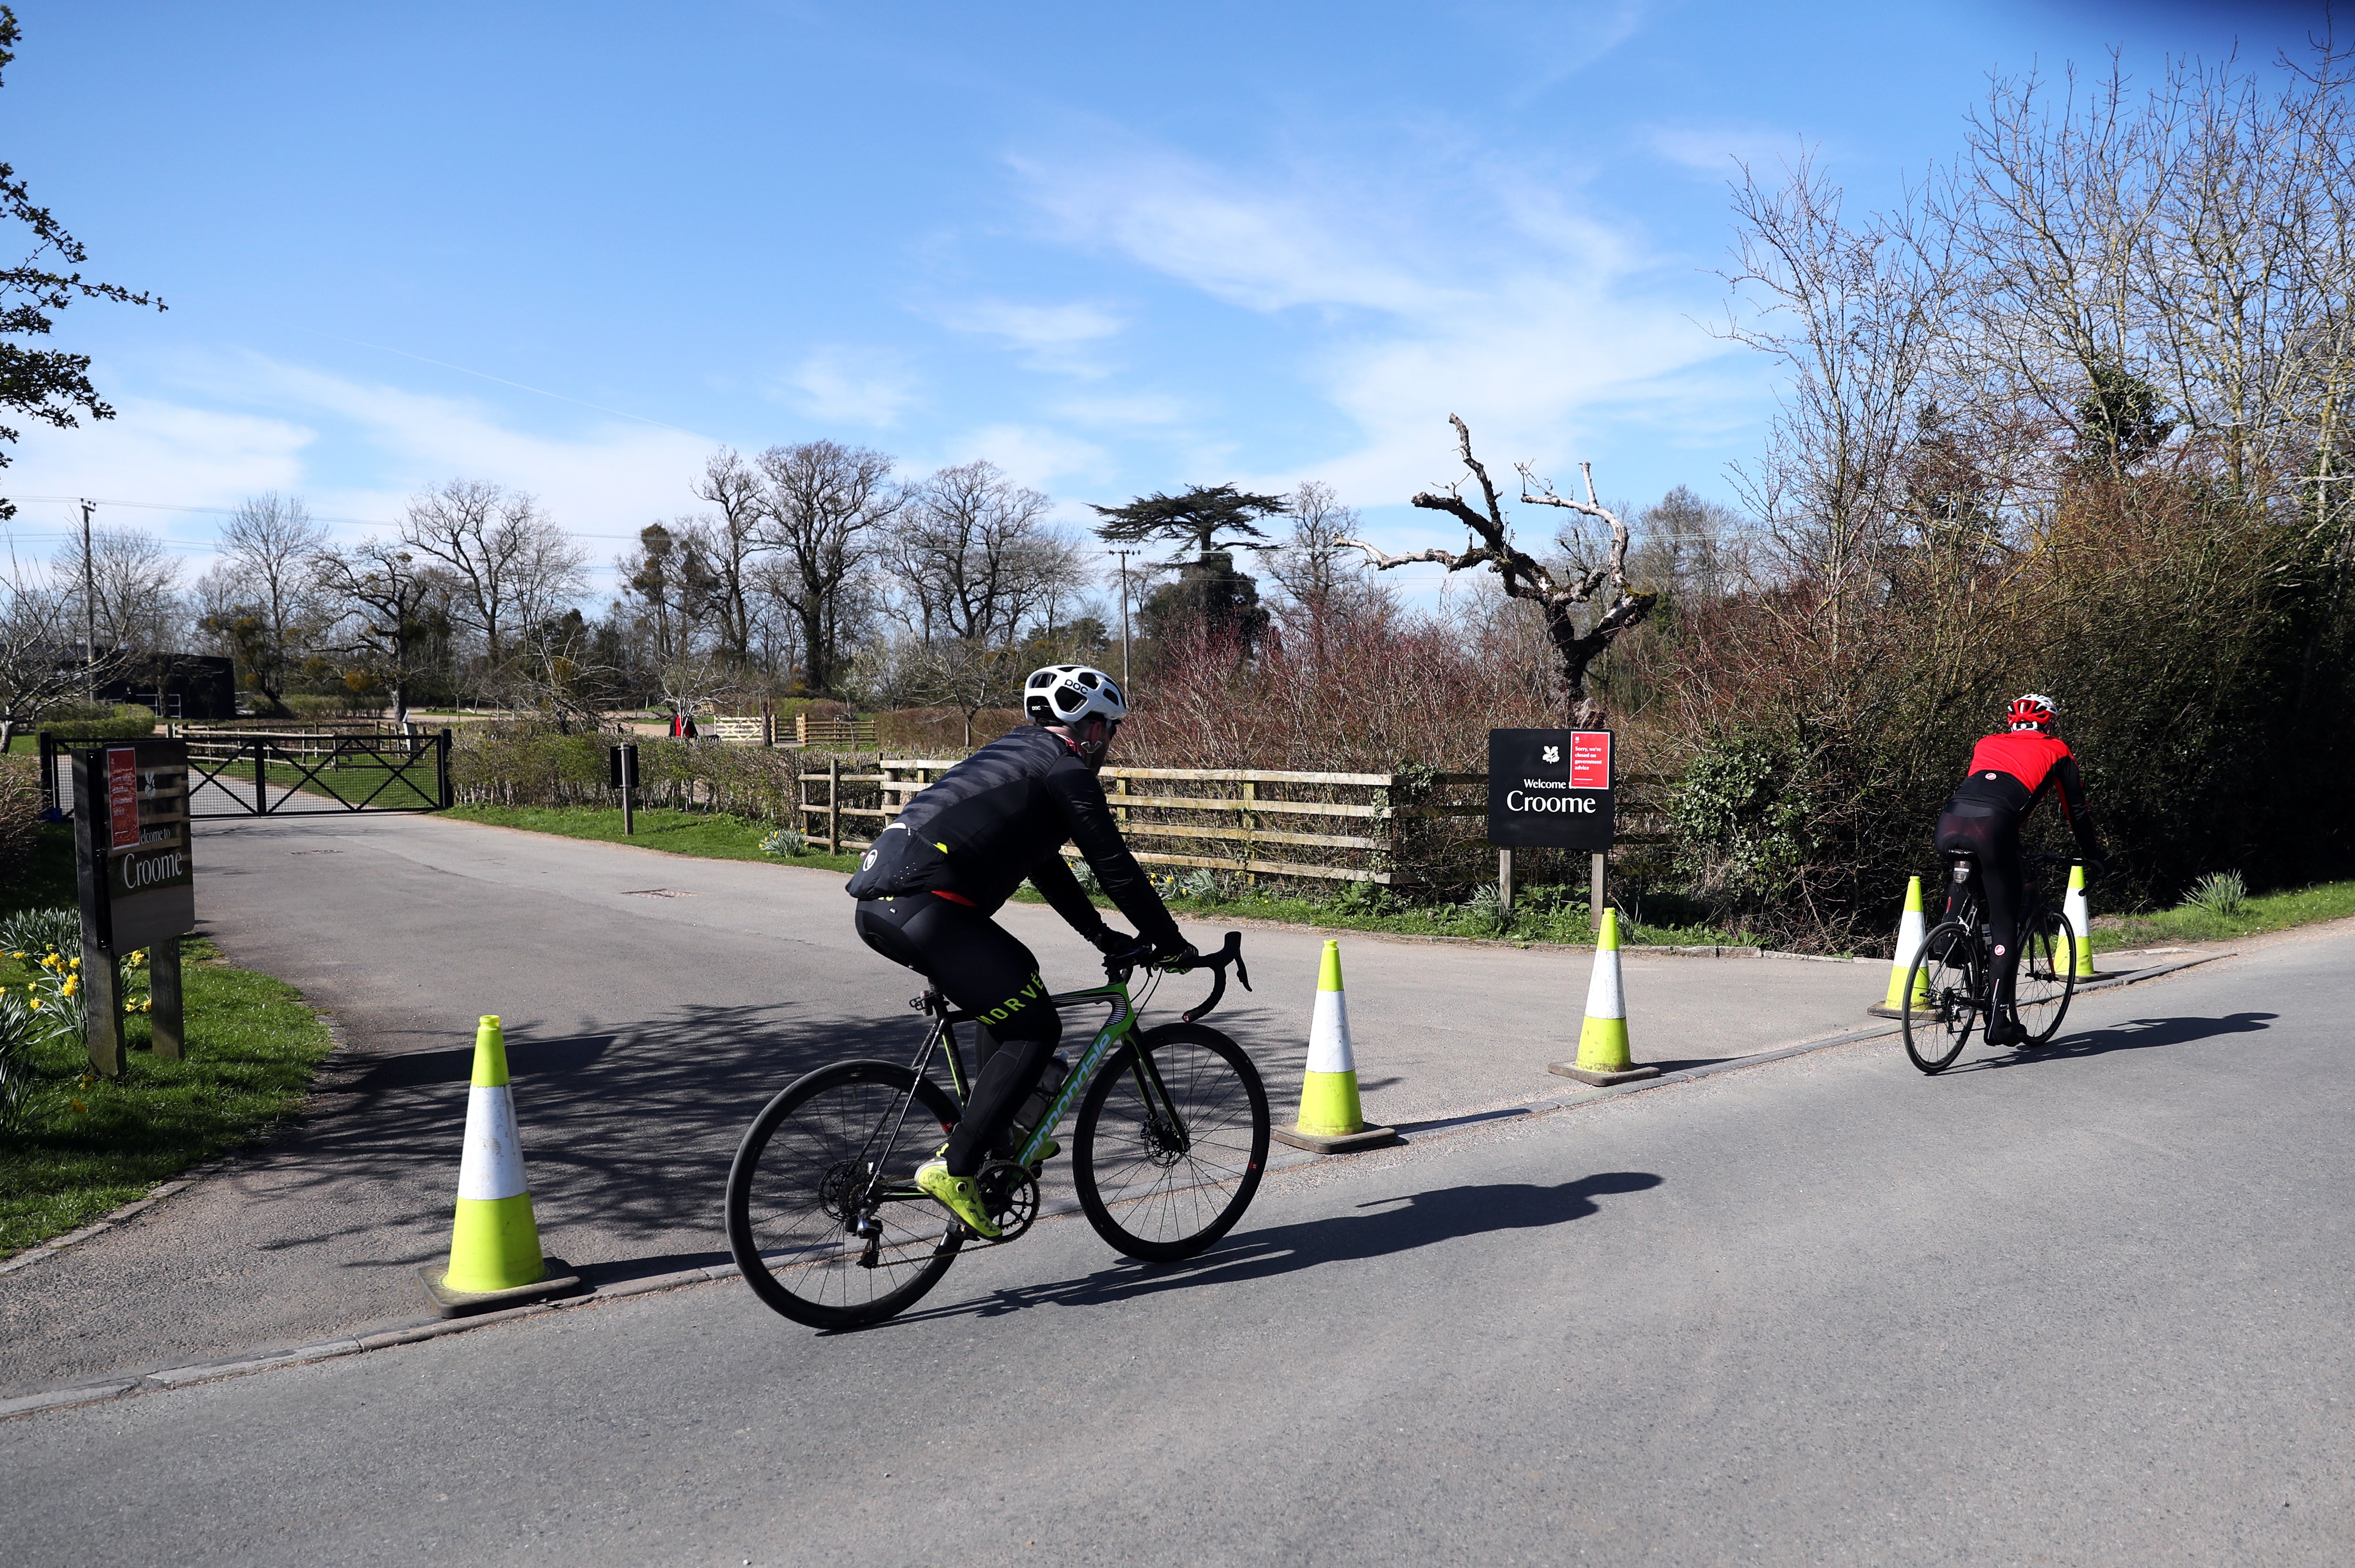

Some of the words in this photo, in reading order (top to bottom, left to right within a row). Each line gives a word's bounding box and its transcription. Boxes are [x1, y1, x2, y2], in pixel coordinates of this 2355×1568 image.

[1523, 778, 1566, 789] Welcome
[1506, 790, 1596, 813] Croome
[140, 829, 163, 844] elcome
[164, 828, 171, 840] to
[123, 852, 183, 889] Croome
